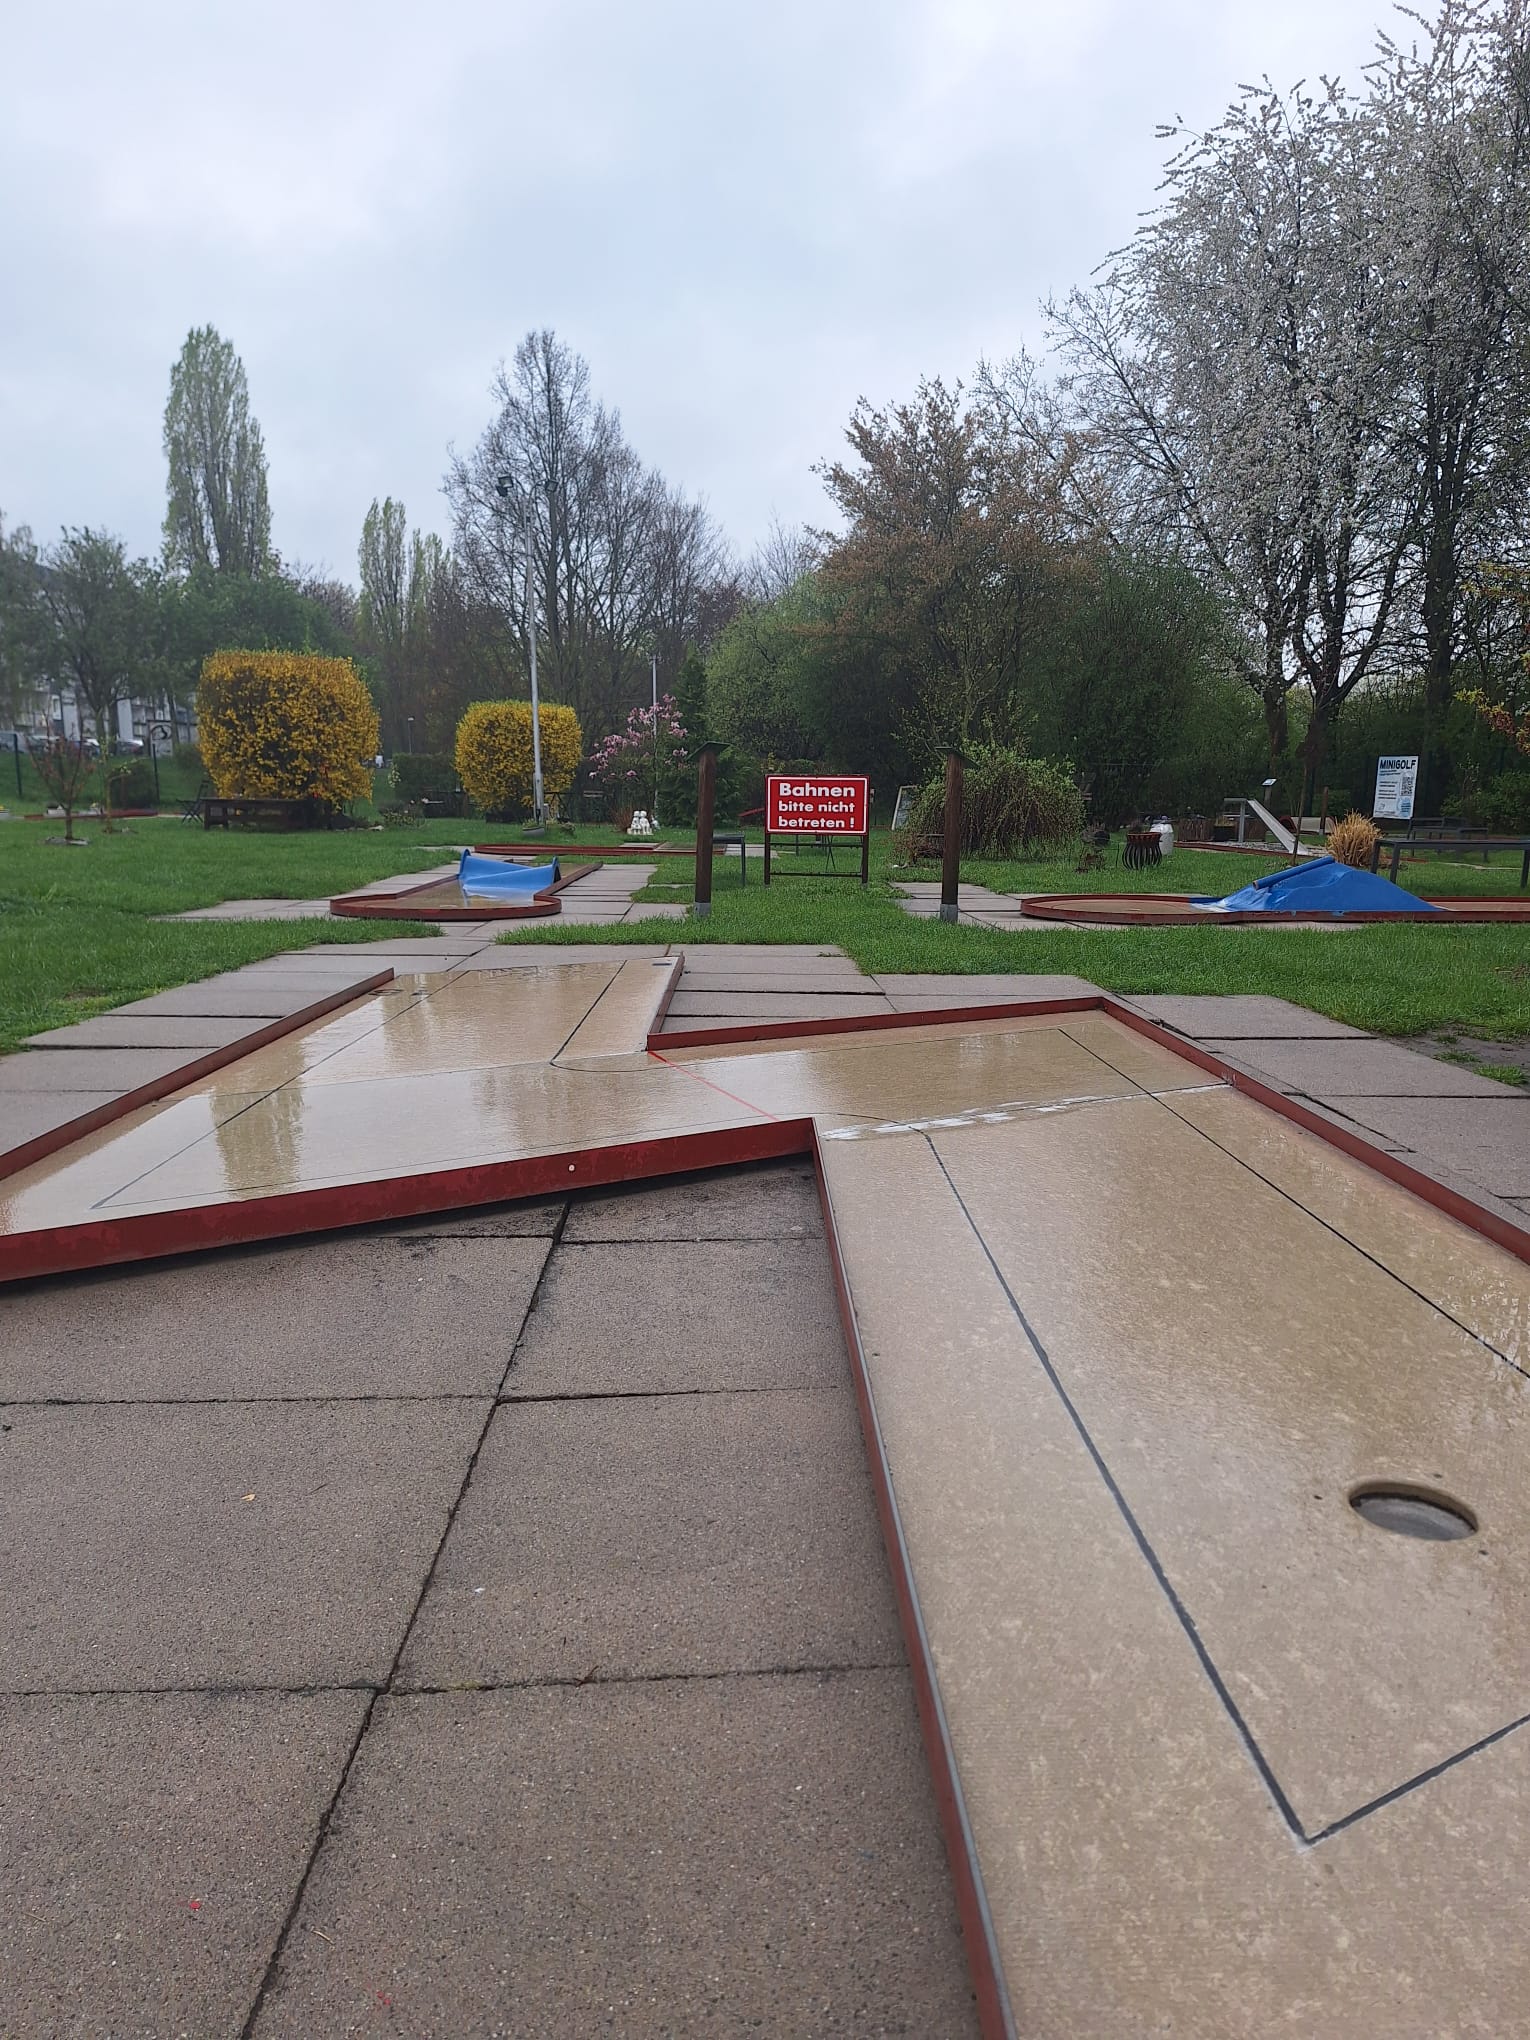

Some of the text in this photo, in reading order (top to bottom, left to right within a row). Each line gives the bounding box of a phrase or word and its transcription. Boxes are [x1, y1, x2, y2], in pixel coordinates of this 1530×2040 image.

[1379, 760, 1417, 769] MINIGOLF
[779, 782, 855, 797] Bahnen
[778, 800, 855, 813] bitte nicht
[778, 816, 855, 828] betreten !
